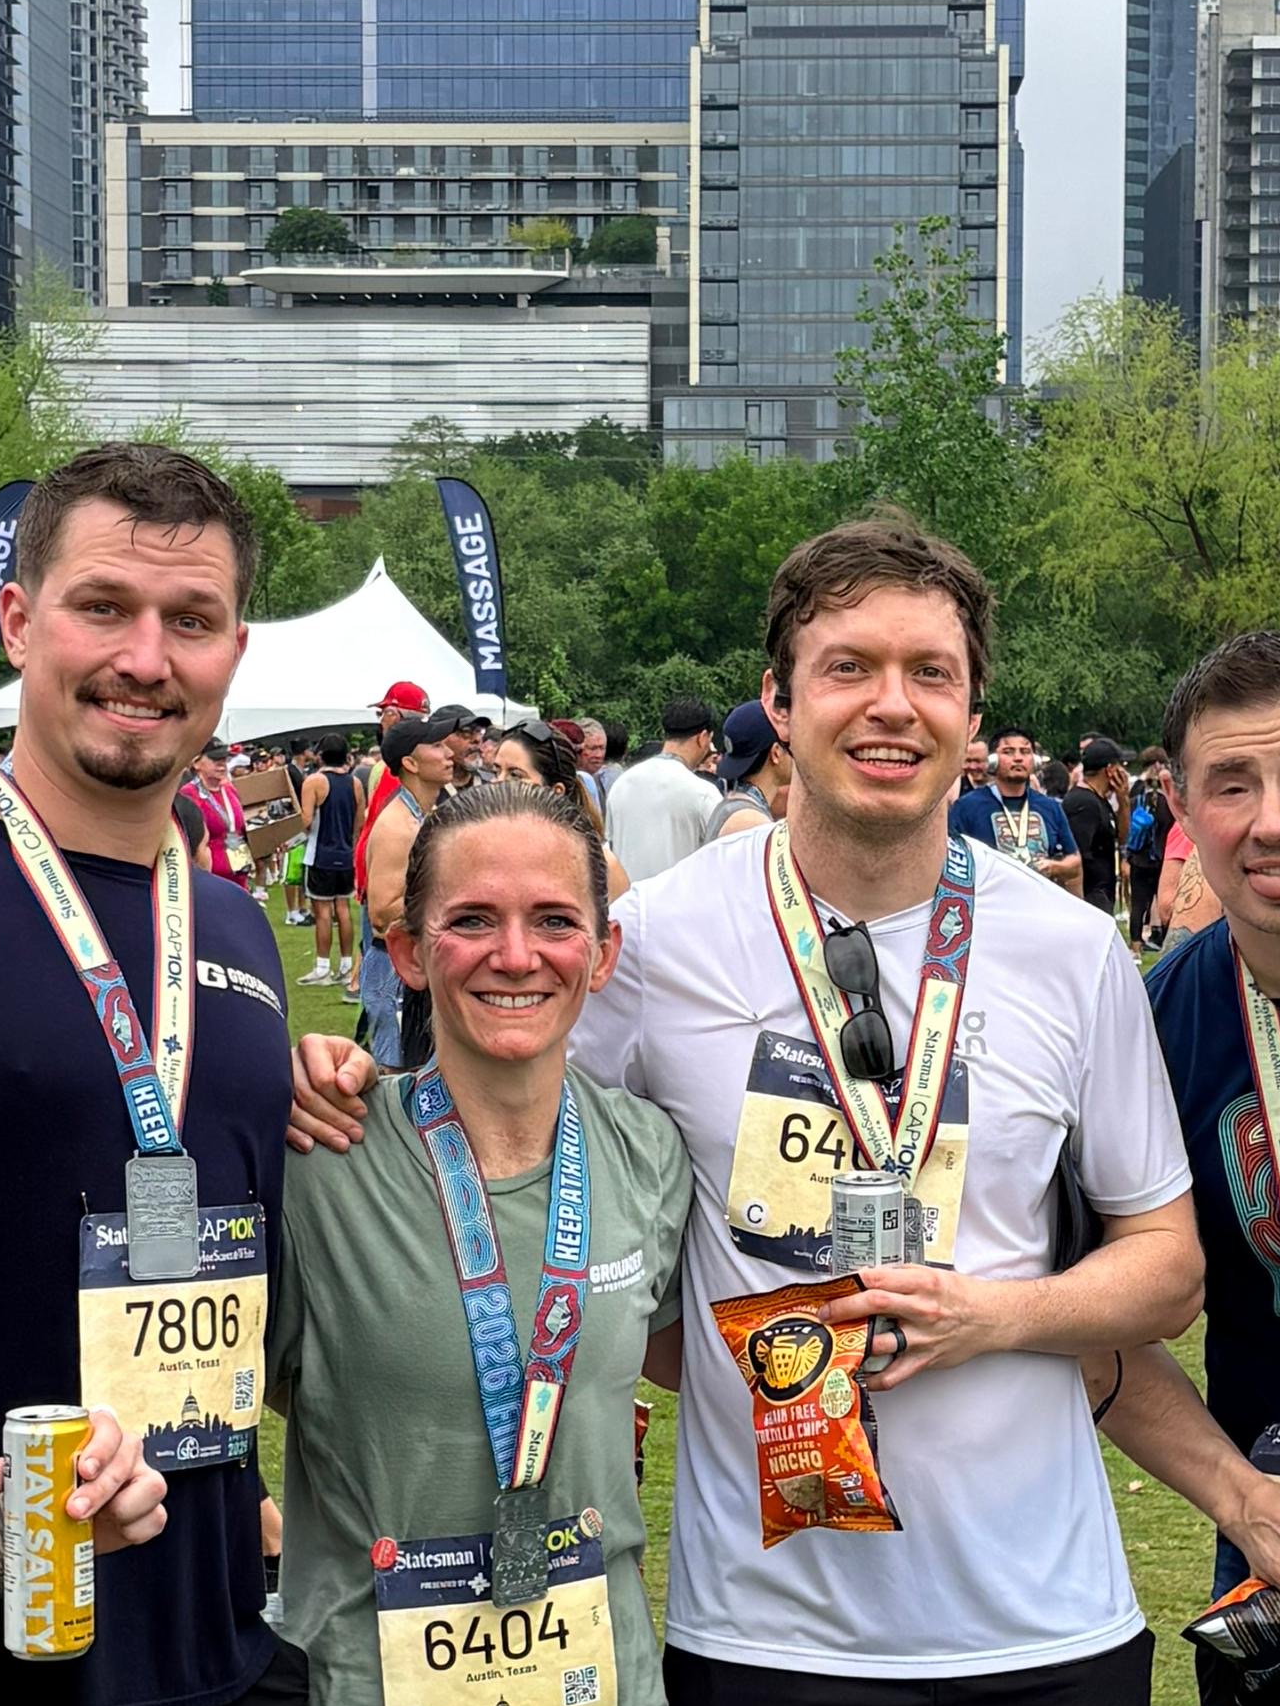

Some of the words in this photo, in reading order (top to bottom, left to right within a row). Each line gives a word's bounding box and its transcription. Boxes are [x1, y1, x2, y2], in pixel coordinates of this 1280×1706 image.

[454, 513, 502, 670] MASSAGE
[39, 857, 79, 921] Statesman
[161, 847, 180, 904] Statesman
[776, 853, 800, 910] Statesman
[165, 912, 184, 992] CAP10K
[917, 1027, 943, 1090] Statesman
[130, 1083, 170, 1148] KEEP
[897, 1100, 929, 1181] CAP10K
[560, 1159, 583, 1204] ATX
[199, 1216, 256, 1243] AP10K
[555, 1204, 583, 1263] KEEP
[746, 1200, 765, 1227] C
[126, 1294, 241, 1357] 7806
[465, 1292, 521, 1393] 2026
[158, 1360, 192, 1373] Austin,
[196, 1358, 220, 1371] Texas
[790, 1402, 817, 1420] FREE
[796, 1419, 829, 1439] CHIPS
[22, 1433, 55, 1522] STAY
[769, 1450, 823, 1475] NACHO
[21, 1527, 55, 1654] SALTY
[394, 1550, 475, 1573] Statesman
[424, 1601, 569, 1672] 6404
[466, 1669, 505, 1684] Austin,
[507, 1663, 538, 1678] Texas
